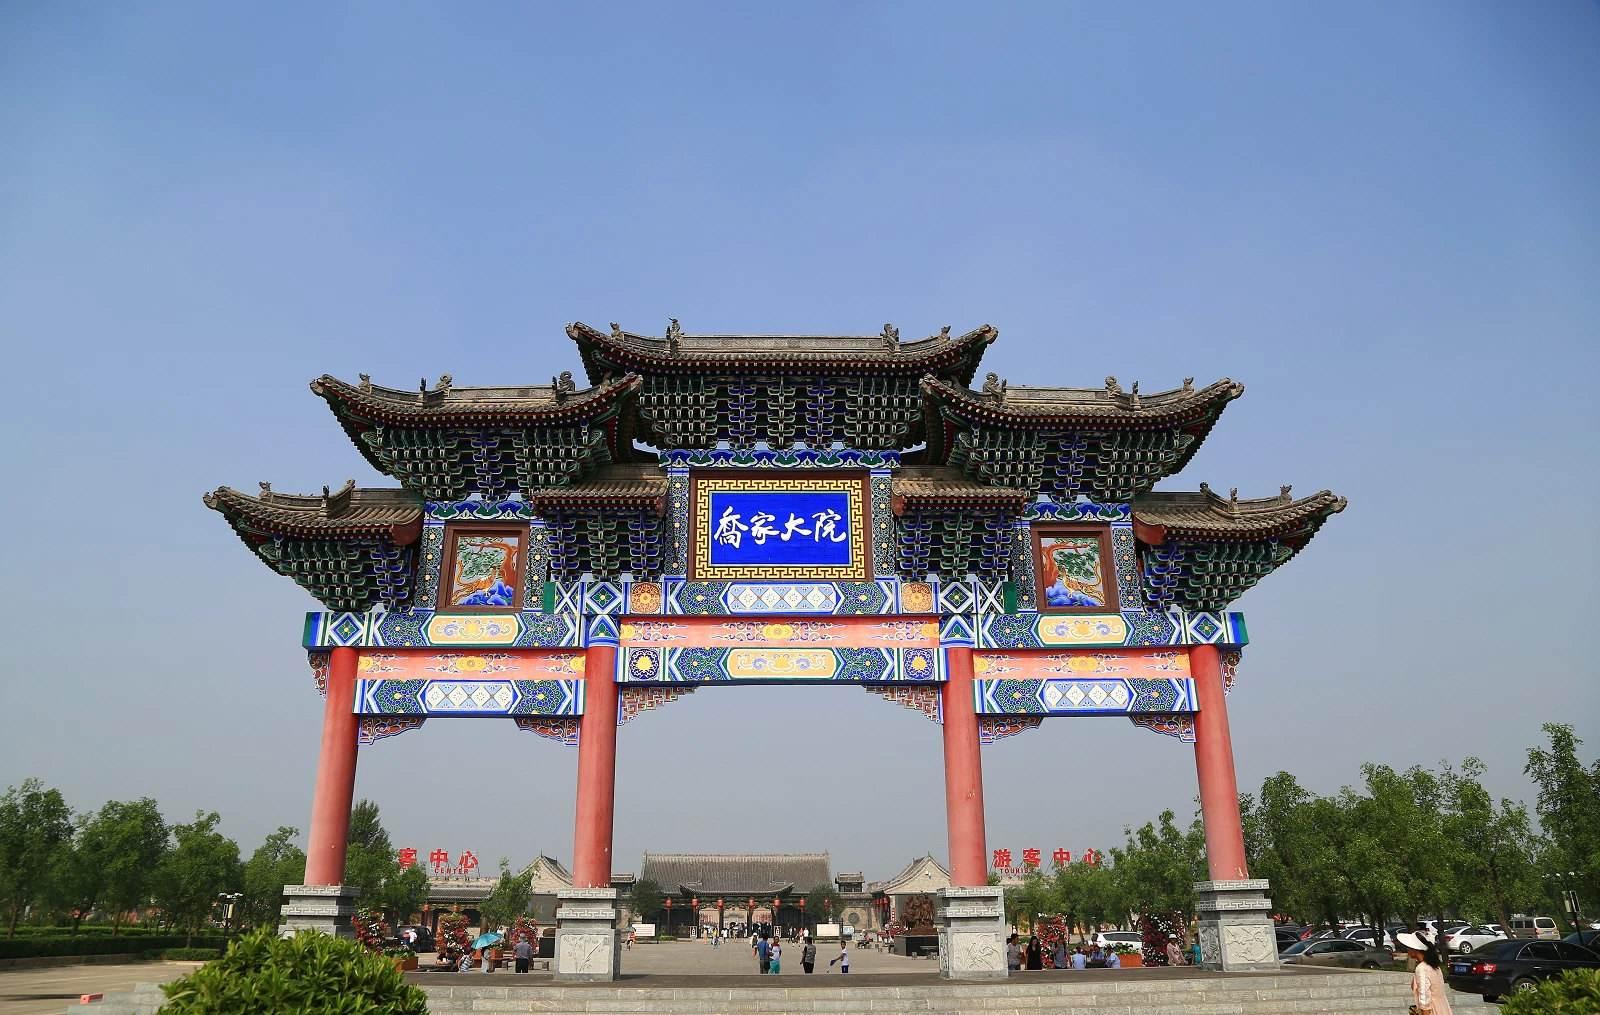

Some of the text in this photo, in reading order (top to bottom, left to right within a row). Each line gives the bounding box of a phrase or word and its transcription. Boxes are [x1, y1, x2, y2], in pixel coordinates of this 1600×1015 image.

[993, 847, 1101, 869] 游客中心
[434, 867, 469, 875] CENTER
